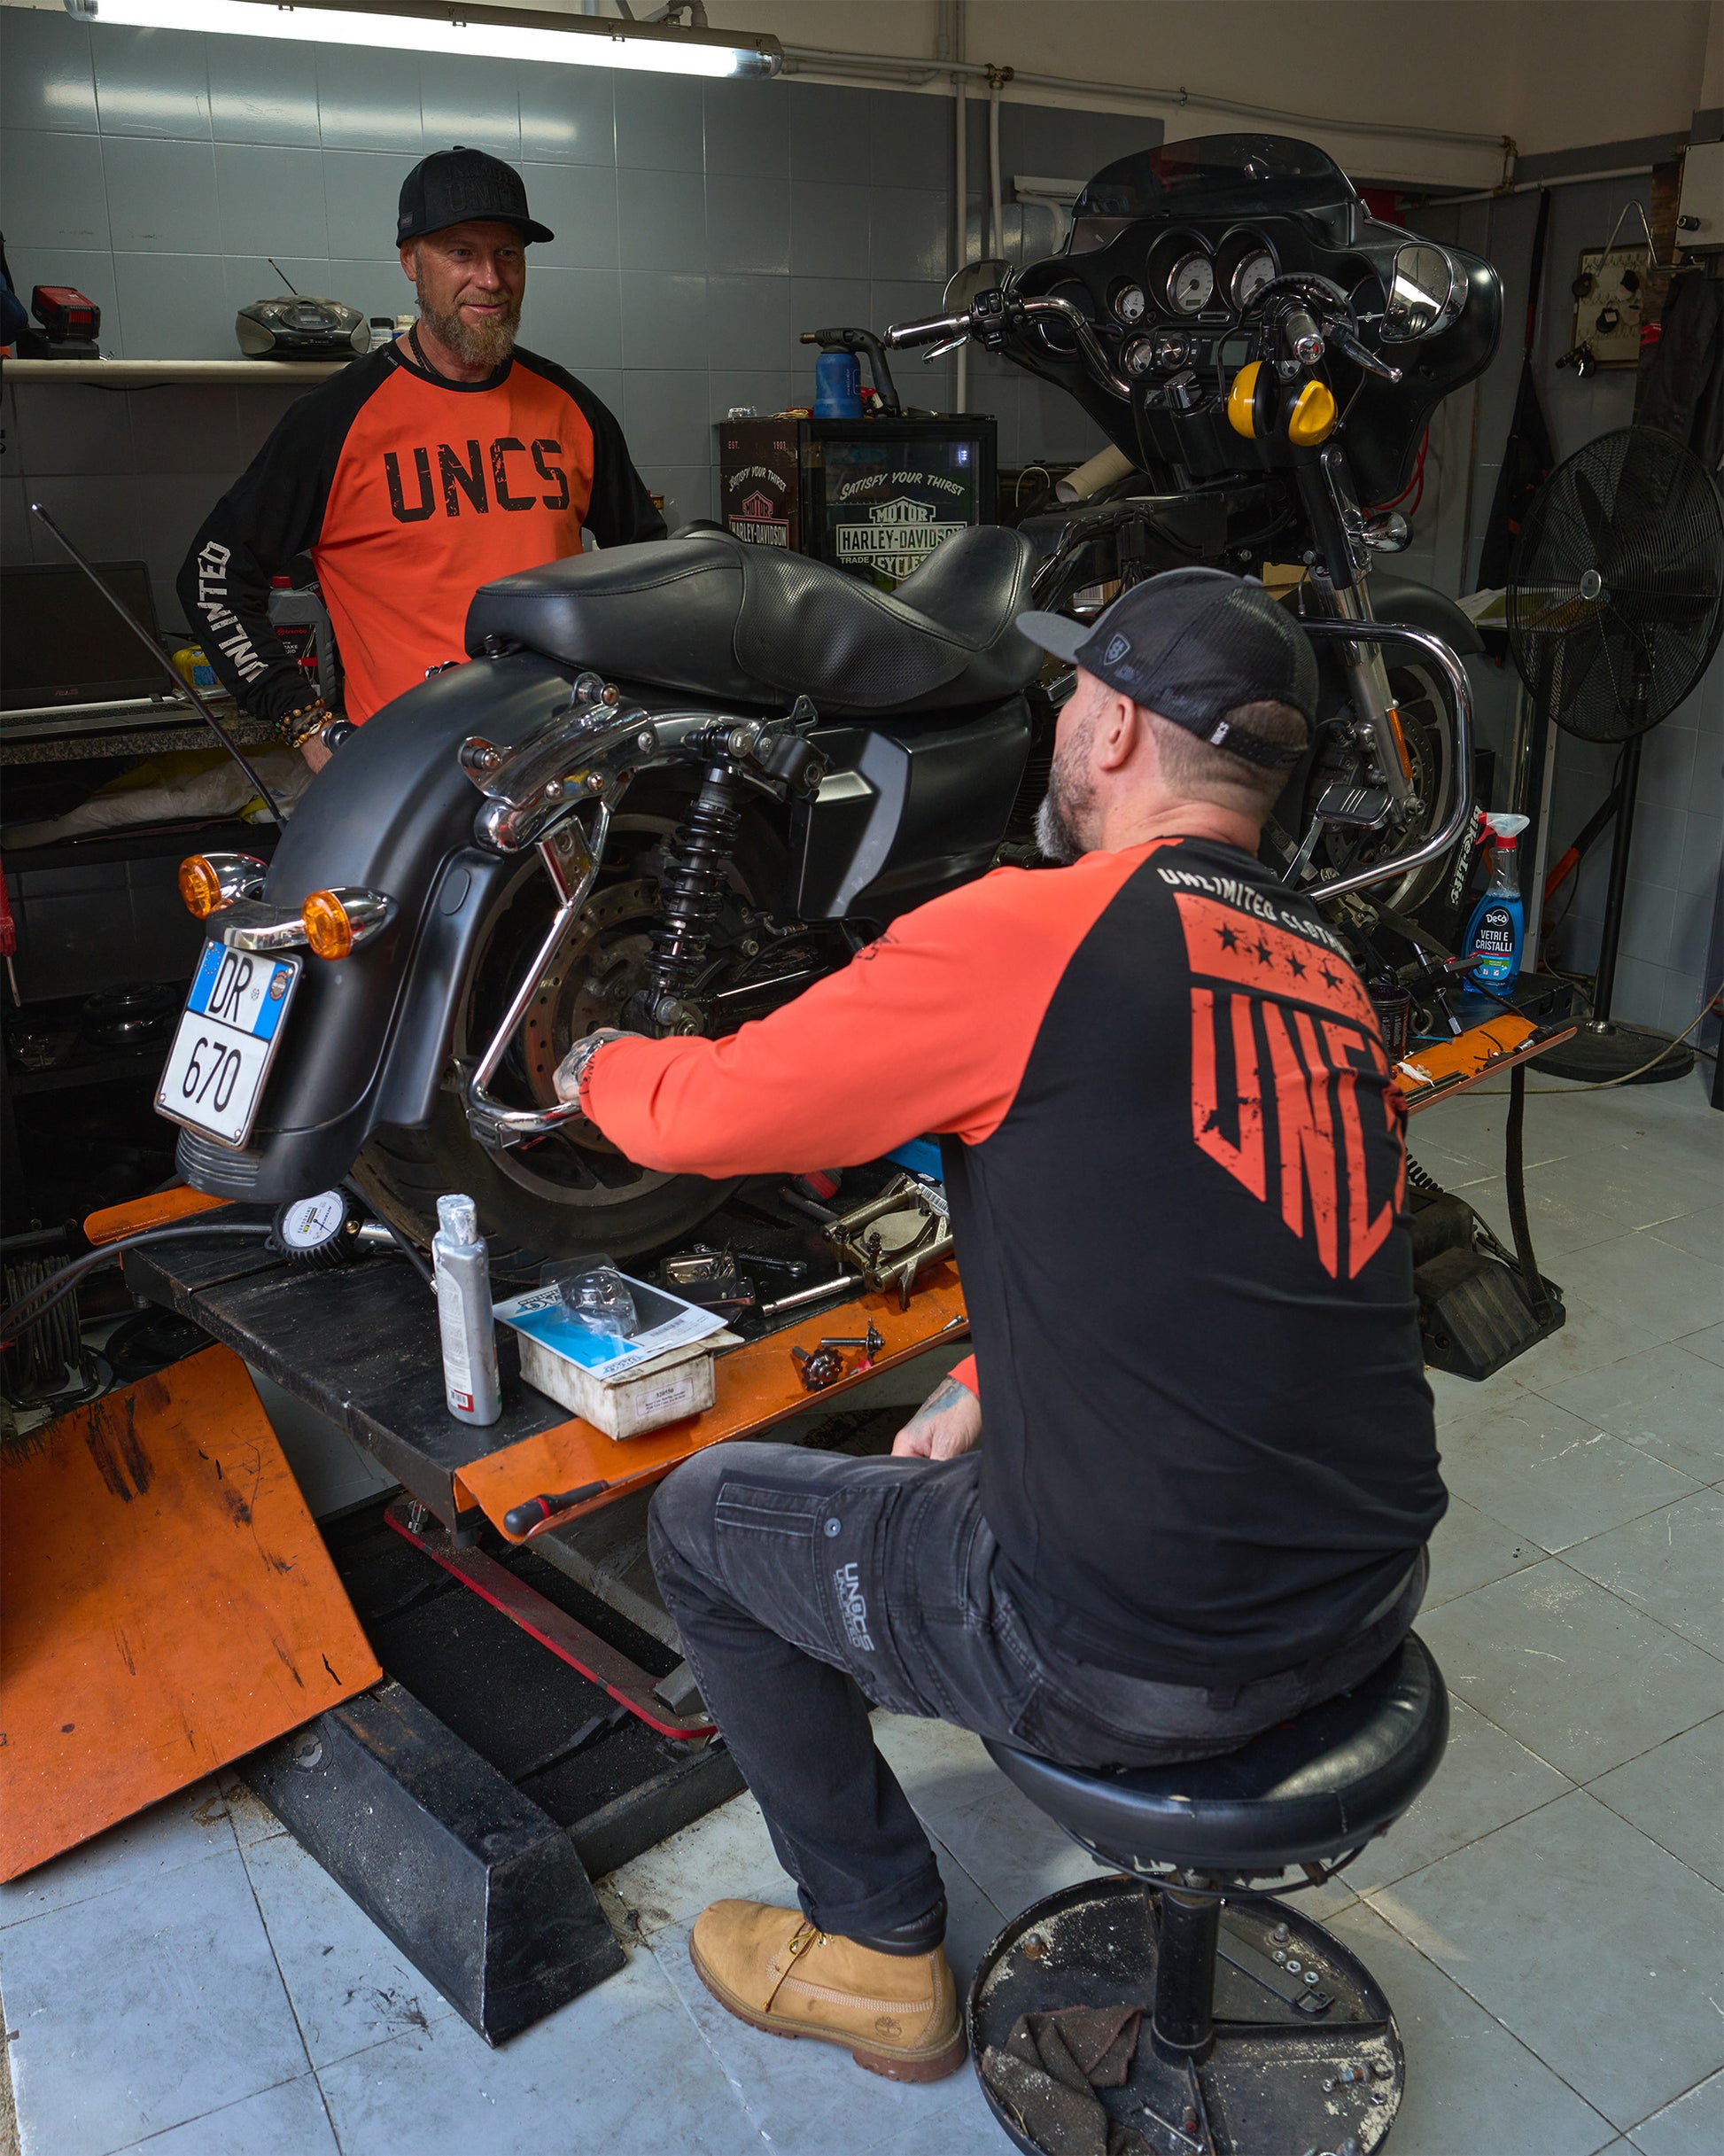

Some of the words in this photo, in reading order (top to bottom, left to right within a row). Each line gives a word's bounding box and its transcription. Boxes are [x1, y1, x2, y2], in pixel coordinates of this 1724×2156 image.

[384, 437, 570, 523] UNCS
[751, 466, 766, 478] YOUR
[767, 469, 787, 492] THIRST
[839, 473, 888, 501] SATISFY
[891, 471, 923, 484] YOUR
[927, 474, 965, 496] THIRST
[875, 500, 928, 523] MOTOR
[198, 541, 269, 683] UNLIMITED
[1156, 868, 1277, 922] UNLIMITED
[1475, 939, 1512, 953] CRISTALLI
[1480, 930, 1502, 941] VETRI
[1503, 931, 1509, 941] E
[208, 951, 254, 1023] DR
[182, 1037, 242, 1112] 670
